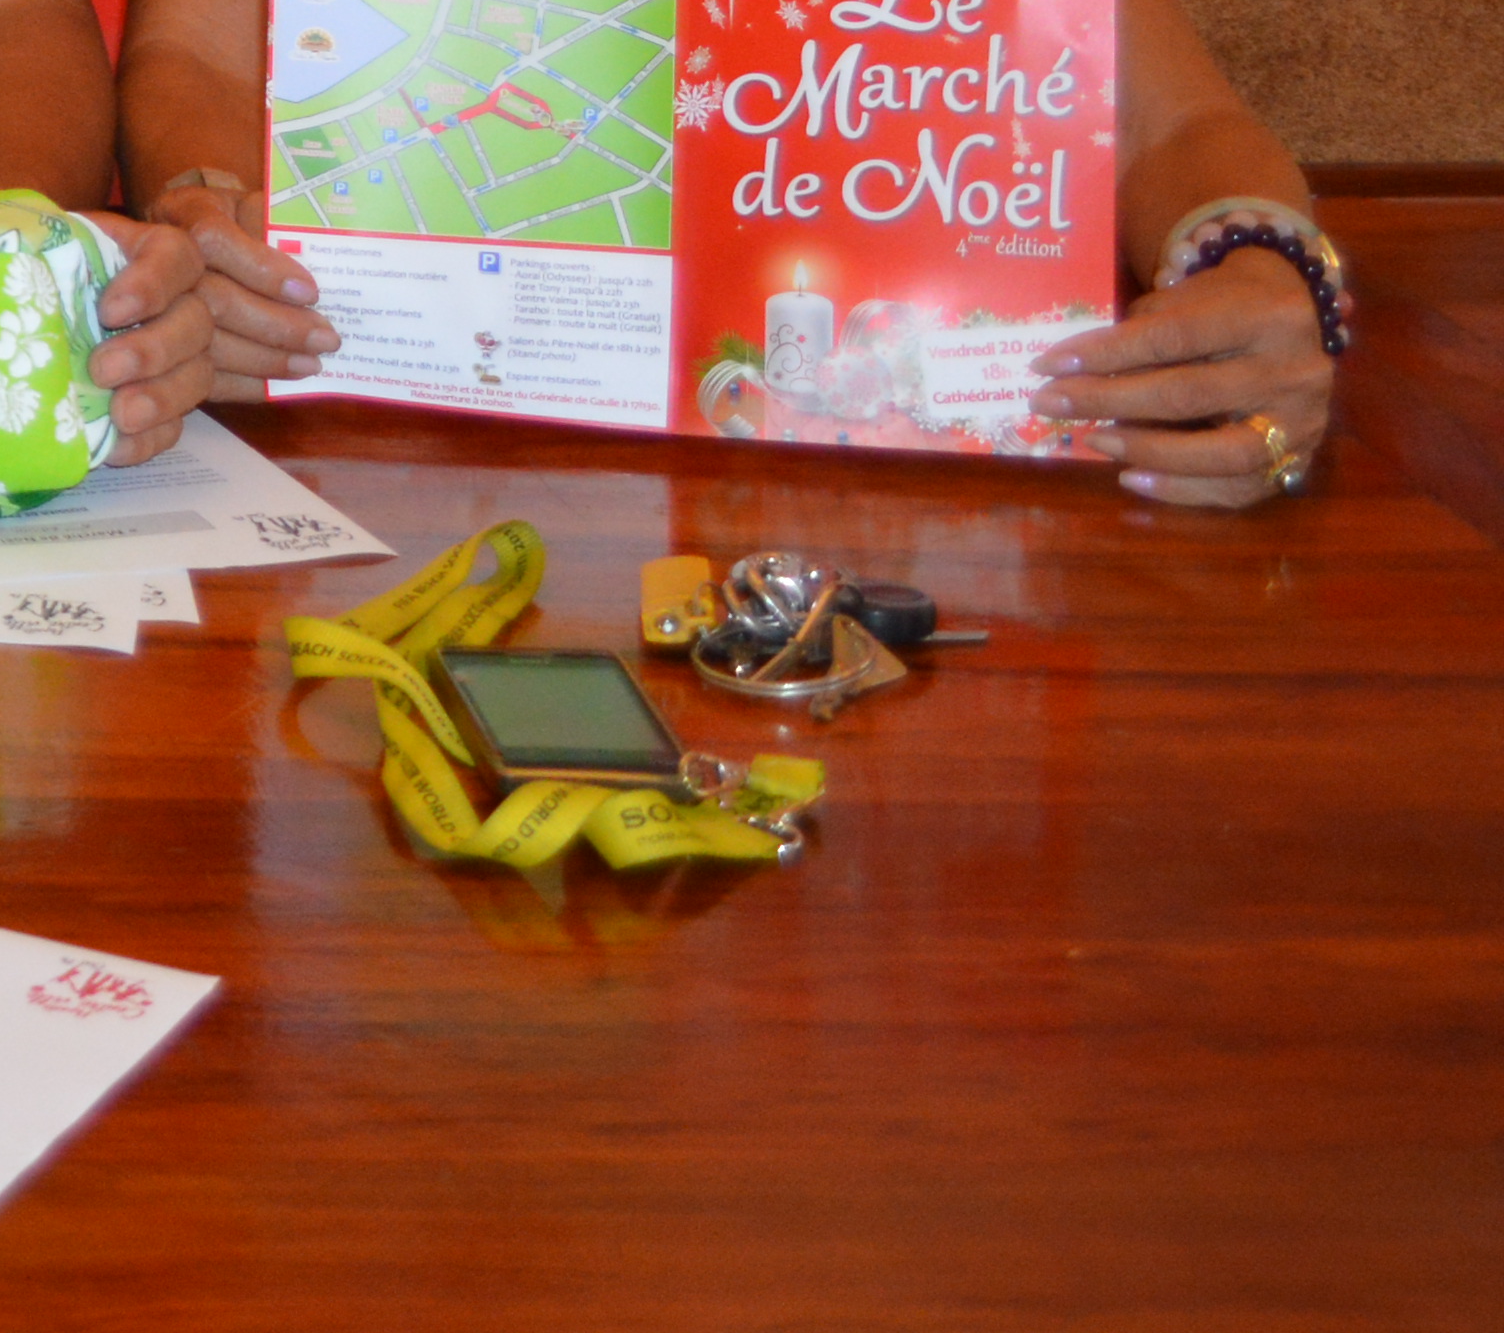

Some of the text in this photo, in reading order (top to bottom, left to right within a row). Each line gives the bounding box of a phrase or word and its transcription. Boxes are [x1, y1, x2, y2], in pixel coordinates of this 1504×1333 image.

[722, 34, 1076, 139] Marché
[731, 127, 1073, 232] de Noël
[995, 233, 1063, 258] édition
[928, 341, 995, 359] Vendredi
[1000, 341, 1022, 354] 20
[933, 387, 1015, 404] Cathédrale
[413, 775, 457, 833] WORLD
[518, 787, 568, 840] WORLD
